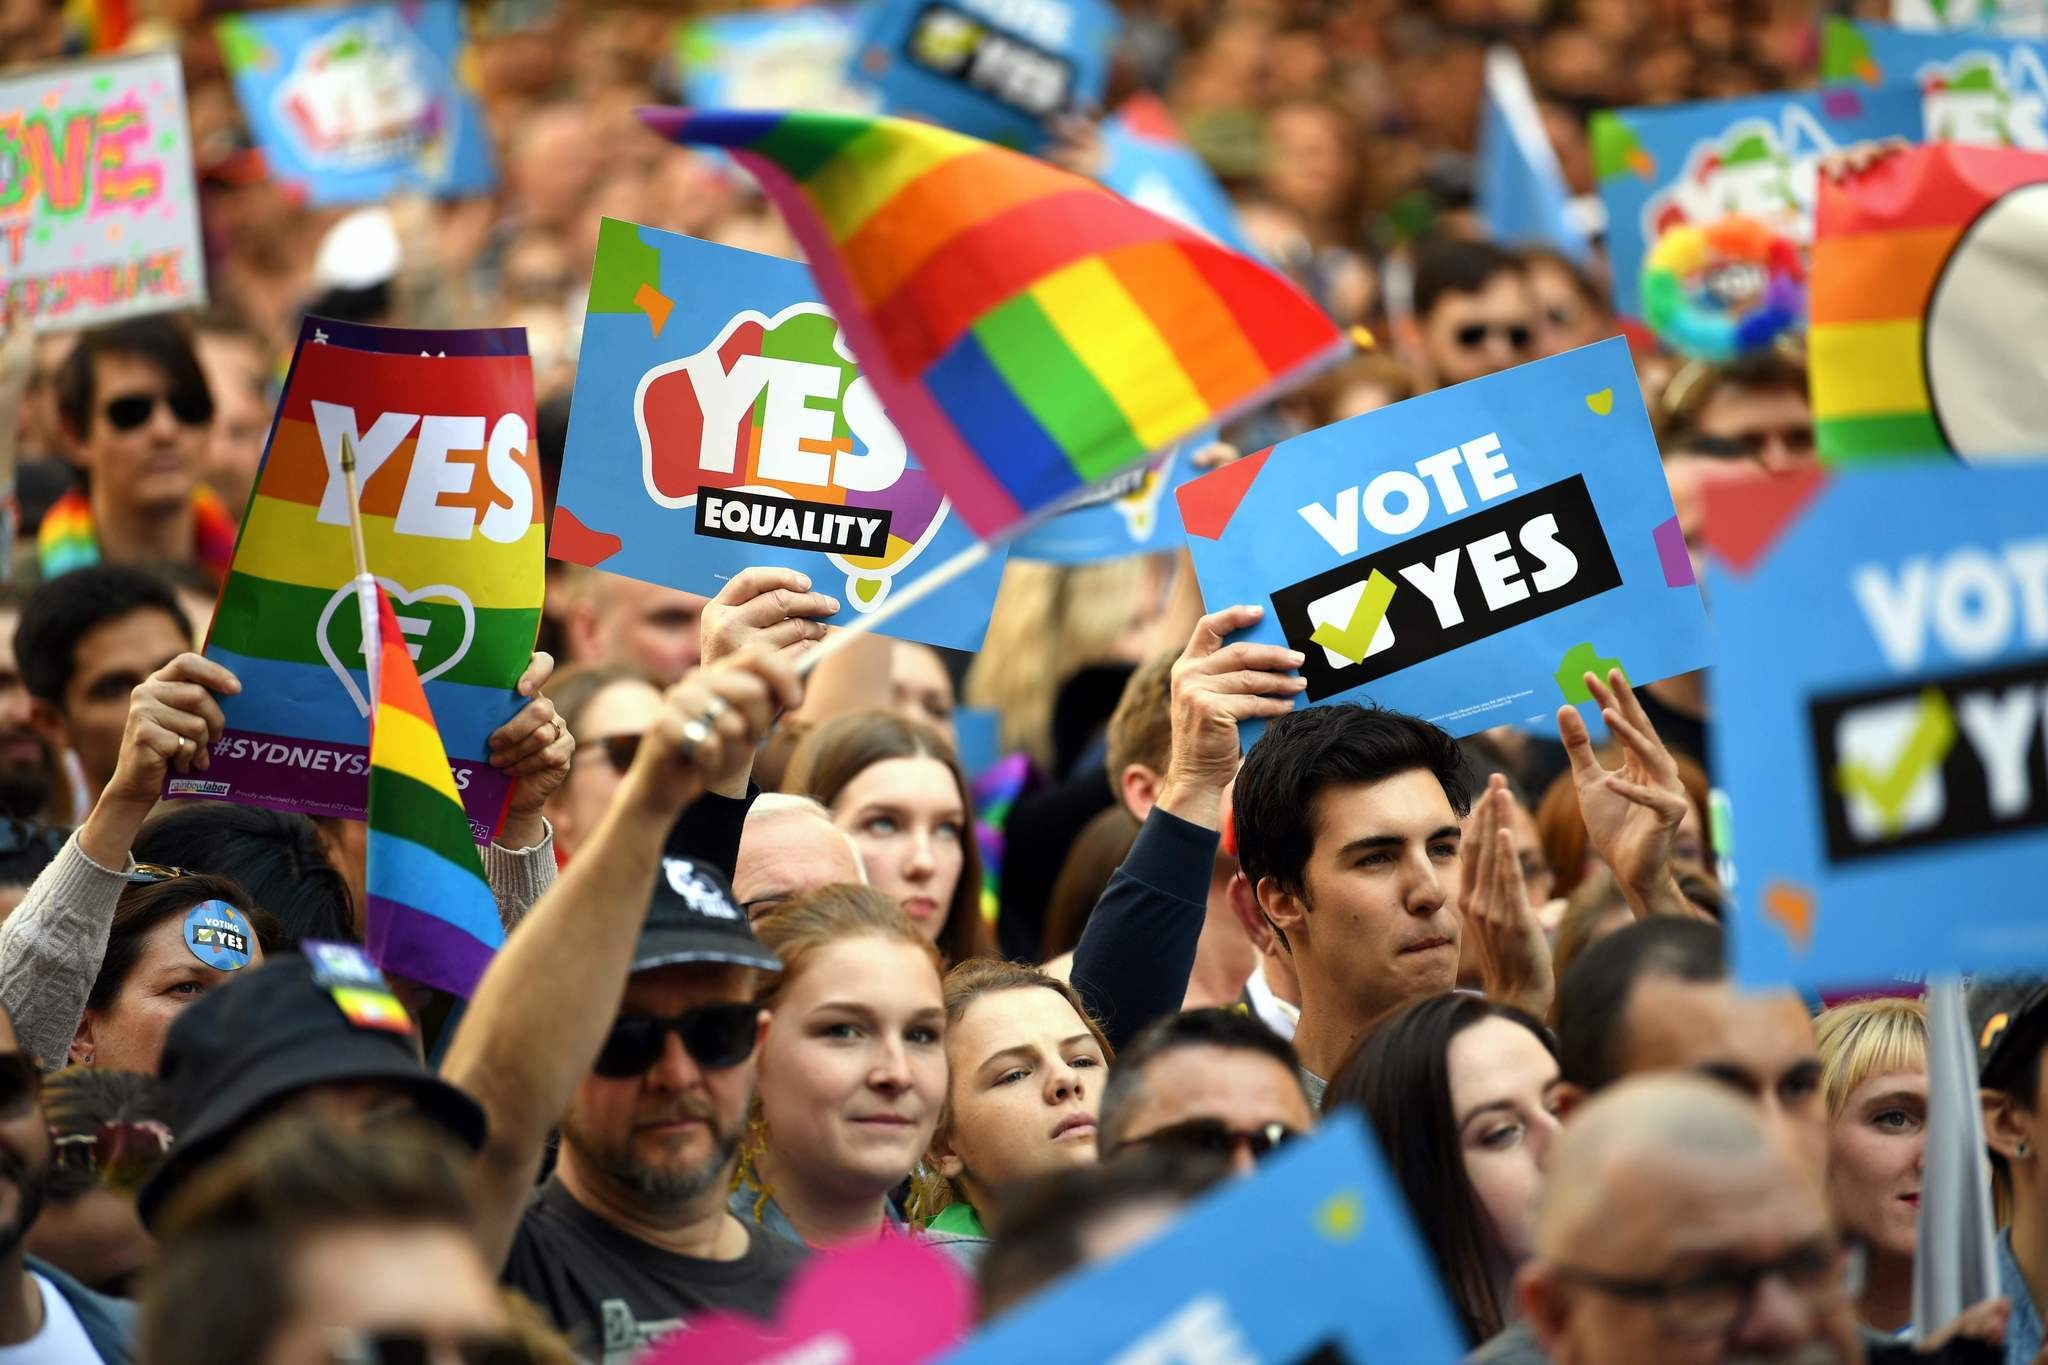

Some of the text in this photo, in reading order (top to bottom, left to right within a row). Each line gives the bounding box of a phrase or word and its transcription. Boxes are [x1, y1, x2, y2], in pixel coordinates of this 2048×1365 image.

[0, 96, 165, 222] OVE
[311, 400, 534, 544] YES
[686, 345, 908, 492] YES
[704, 497, 883, 548] EQUALITY
[1297, 432, 1519, 557] VOTE
[1397, 512, 1580, 630] YES
[1853, 538, 2048, 672] VOT
[214, 736, 473, 790] #SYDNEYSS
[204, 917, 240, 933] VOTING
[216, 930, 244, 950] YES
